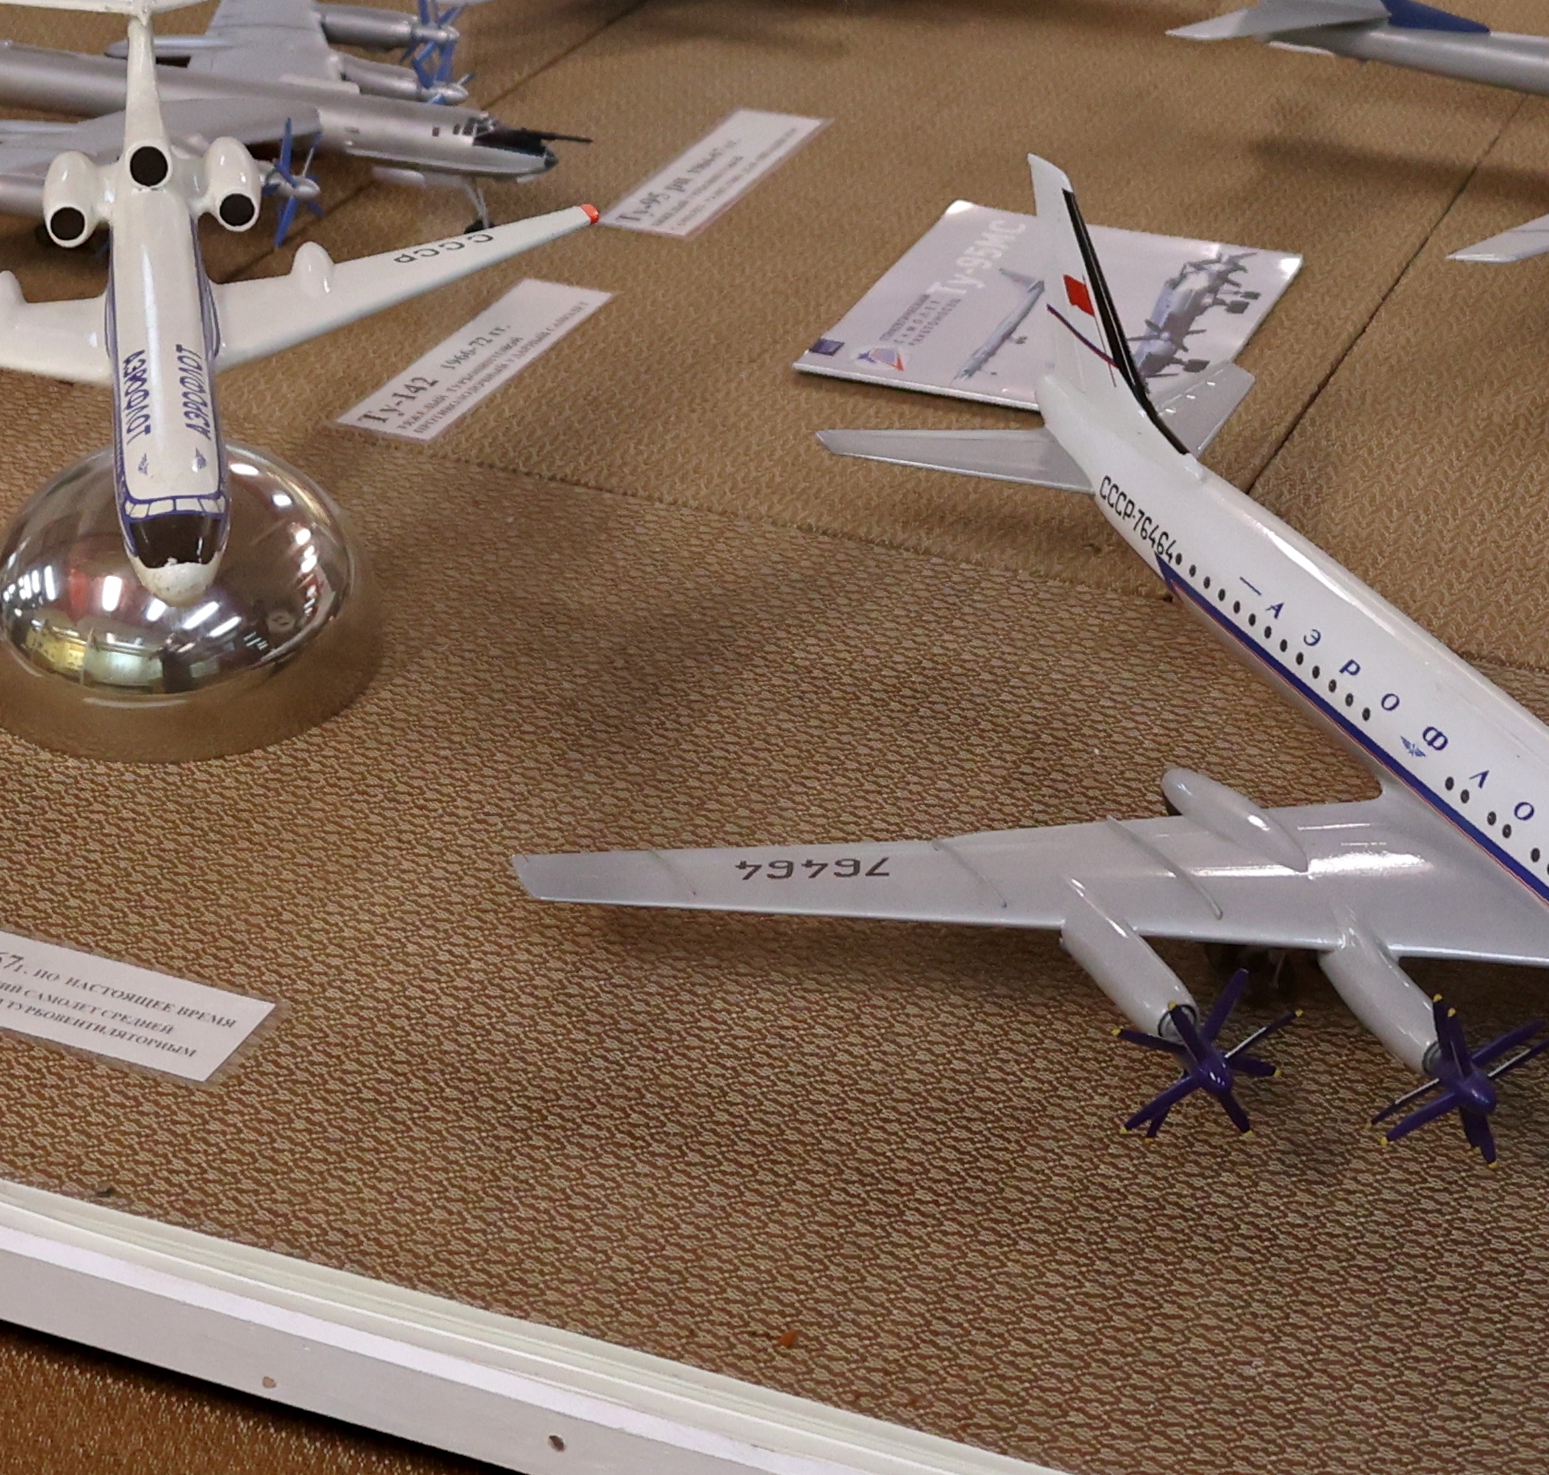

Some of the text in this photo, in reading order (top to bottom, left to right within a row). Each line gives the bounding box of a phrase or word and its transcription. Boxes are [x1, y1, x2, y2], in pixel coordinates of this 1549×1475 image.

[392, 232, 494, 265] СССР
[175, 343, 212, 442] АЭРОФЛОТ
[357, 375, 440, 424] Ту-142
[735, 856, 891, 881] 76464
[23, 987, 102, 1017] САМОЛЕТ
[100, 1008, 175, 1035] СРЕДНЕЙ
[64, 976, 176, 1014] НАСТОЯЩЕЕ
[177, 1005, 238, 1029] ВРЕМЯ
[5, 1000, 198, 1058] ТУРБОВЕНТИЛЯТОРНЫМ
